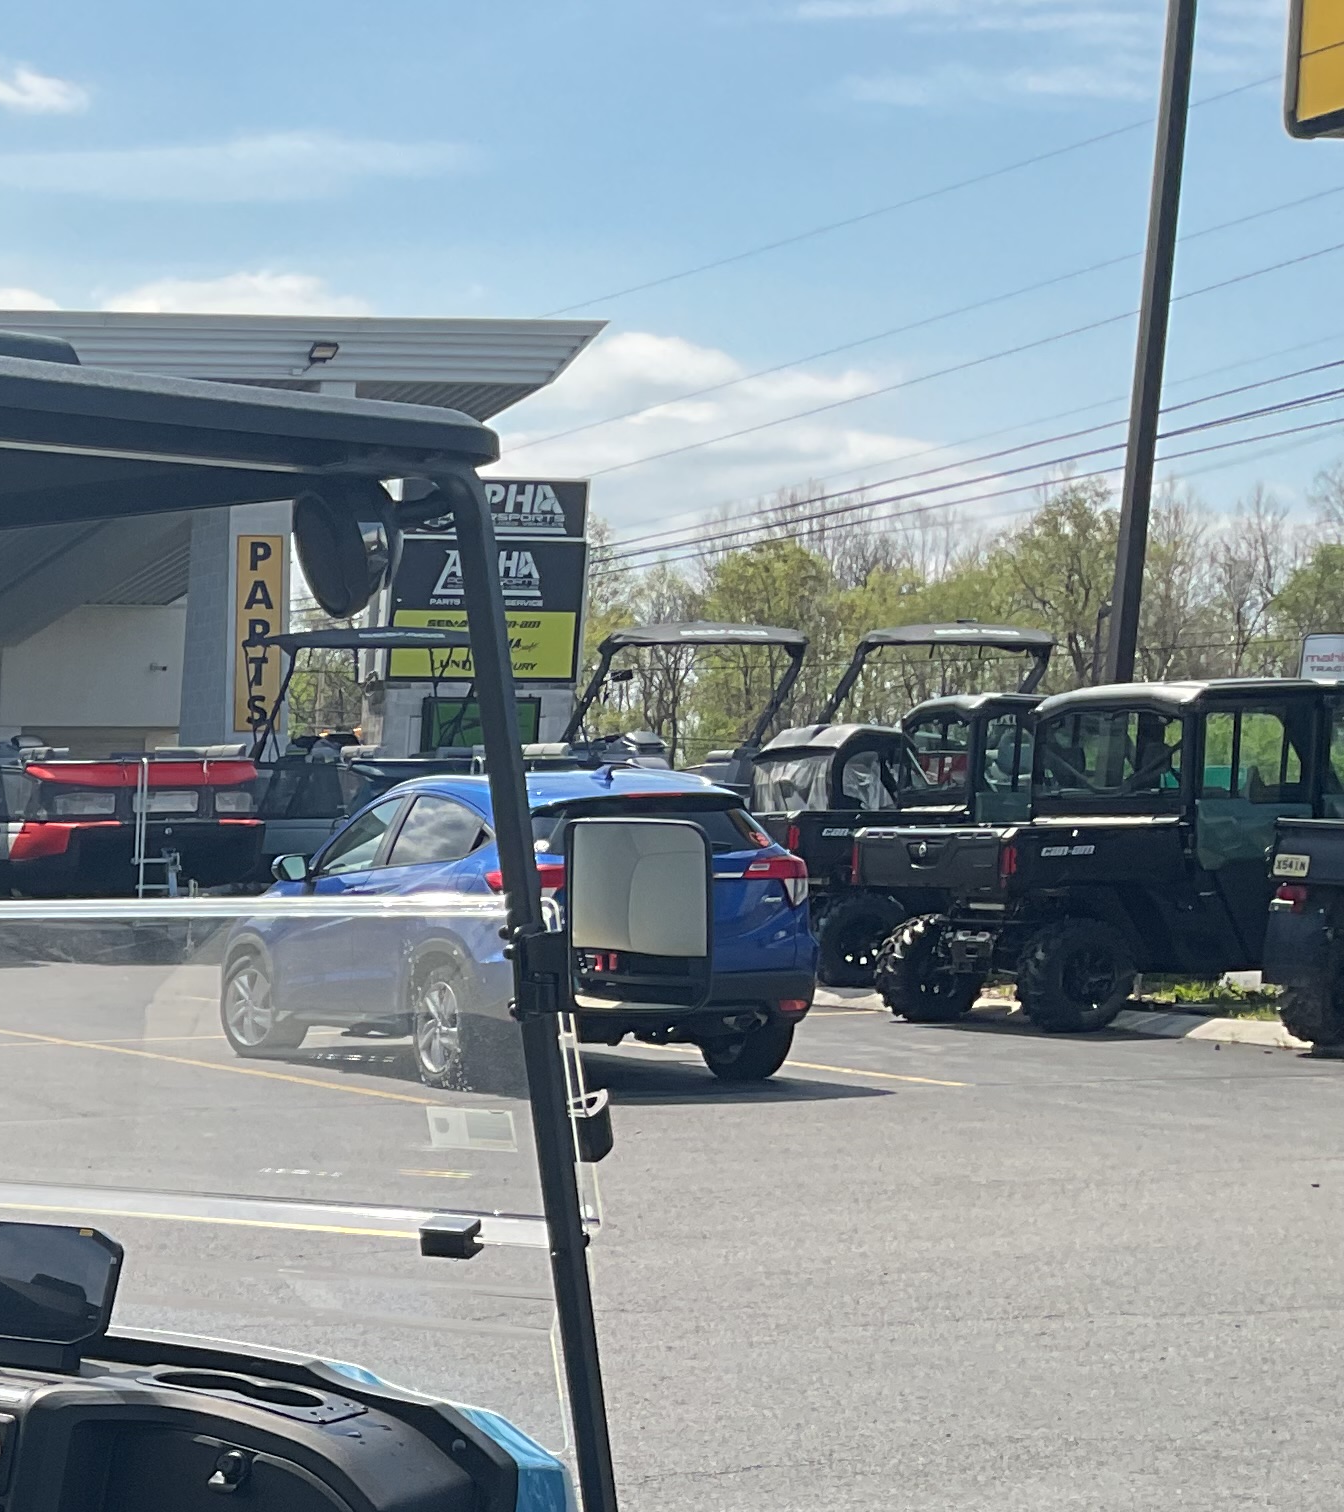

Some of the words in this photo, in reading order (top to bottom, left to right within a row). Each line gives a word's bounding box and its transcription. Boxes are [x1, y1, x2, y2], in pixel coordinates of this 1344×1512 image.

[485, 483, 564, 514] PHA
[491, 513, 565, 522] SPORTS
[244, 541, 274, 726] PARTS
